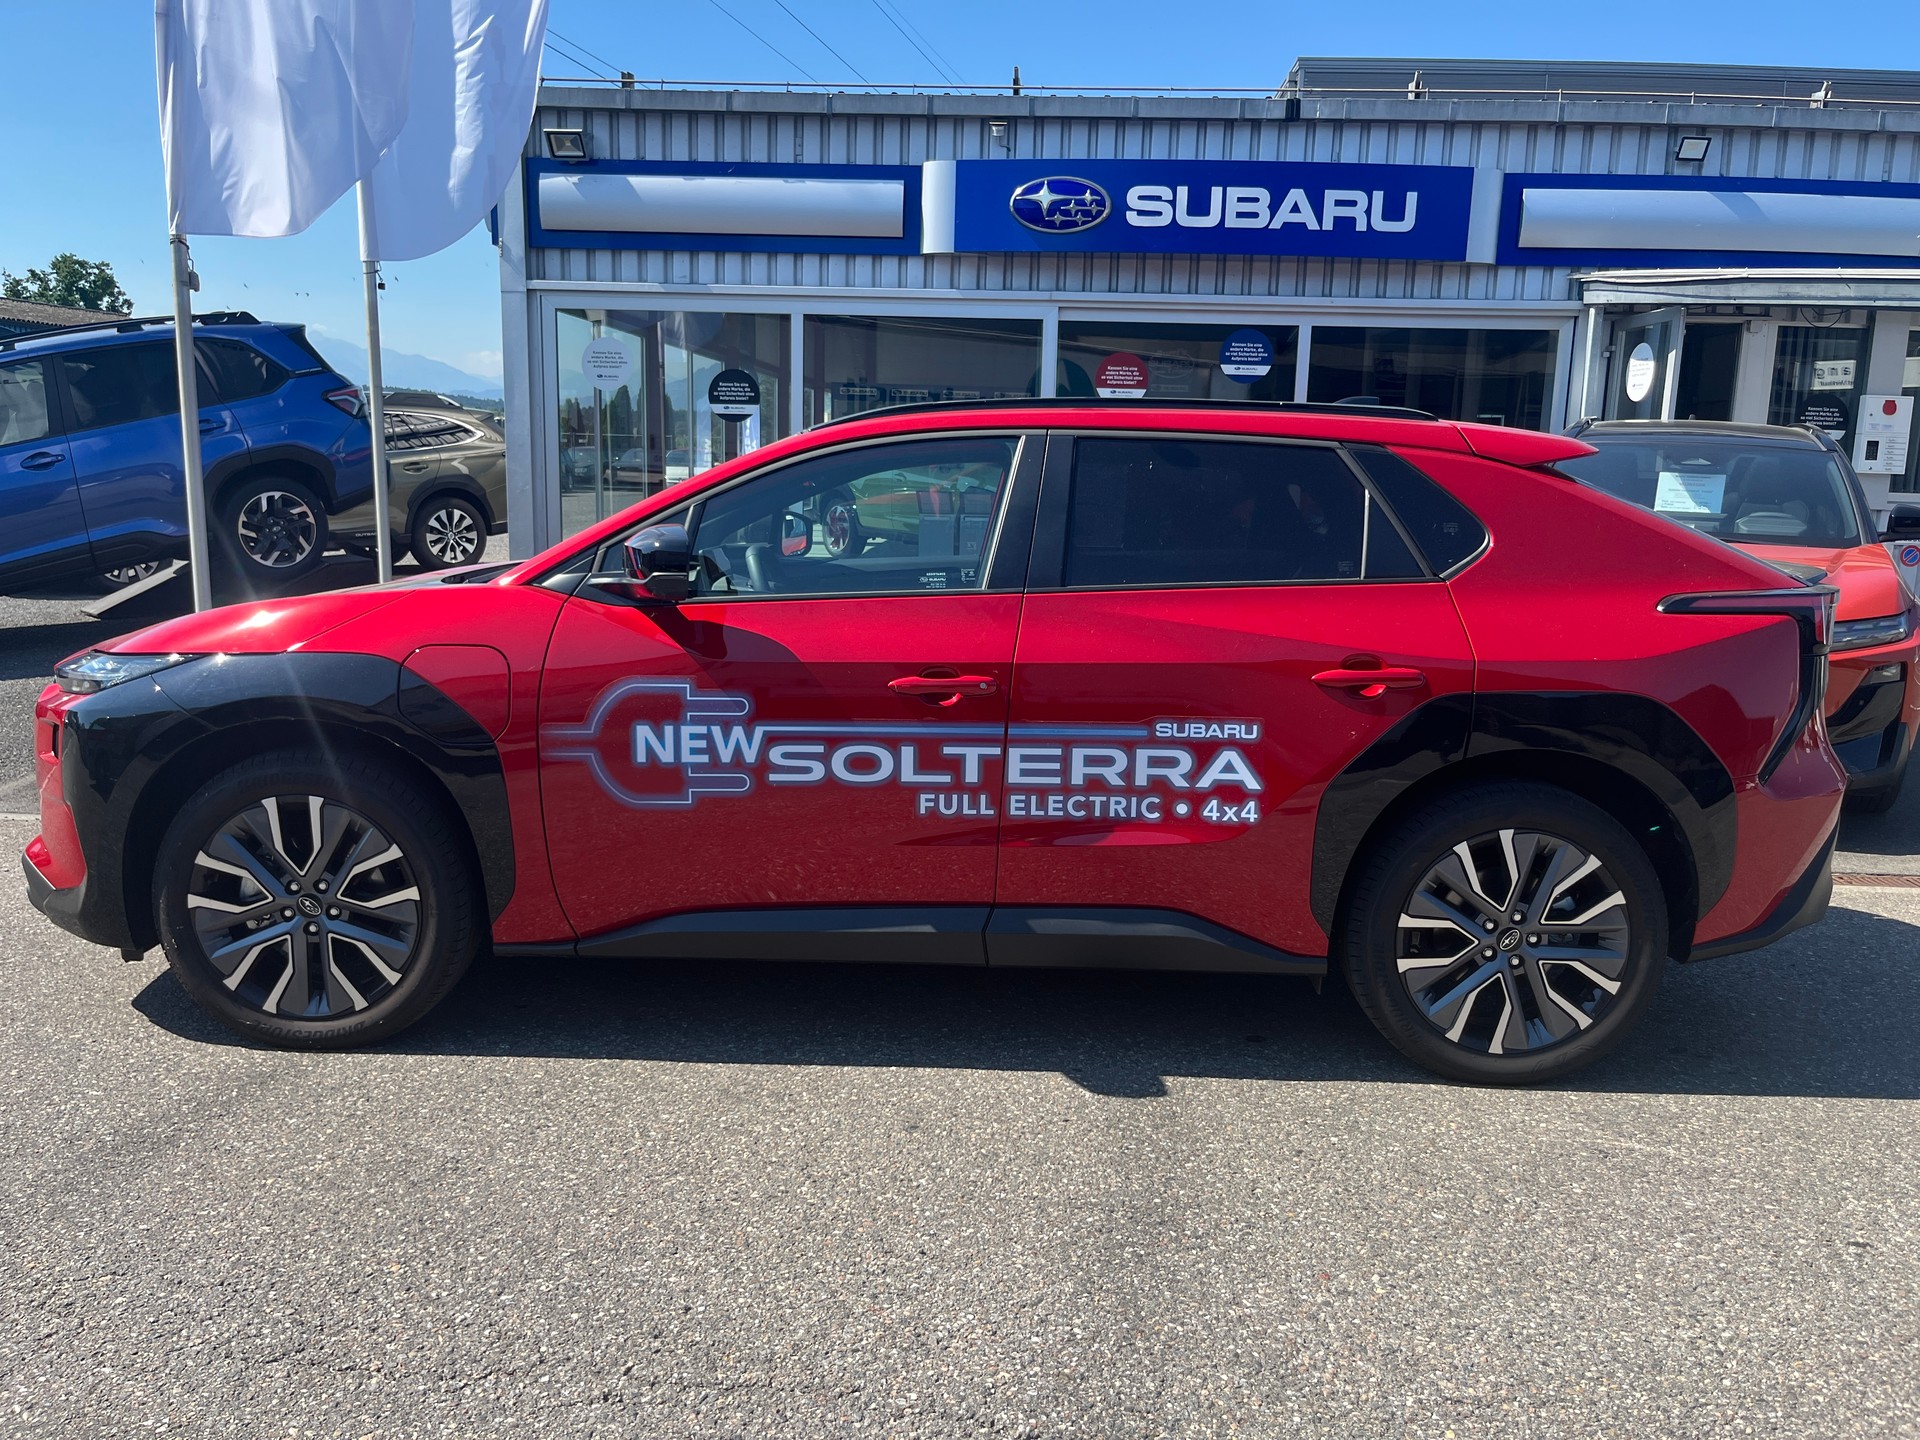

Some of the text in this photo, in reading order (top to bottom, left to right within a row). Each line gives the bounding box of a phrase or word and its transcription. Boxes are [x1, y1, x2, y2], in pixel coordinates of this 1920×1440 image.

[1125, 185, 1418, 232] SUBARU
[1155, 722, 1258, 739] SUBARU
[635, 725, 1262, 790] NEW SOLTERRA
[919, 794, 1258, 822] FULL ELECTRIC 4x4
